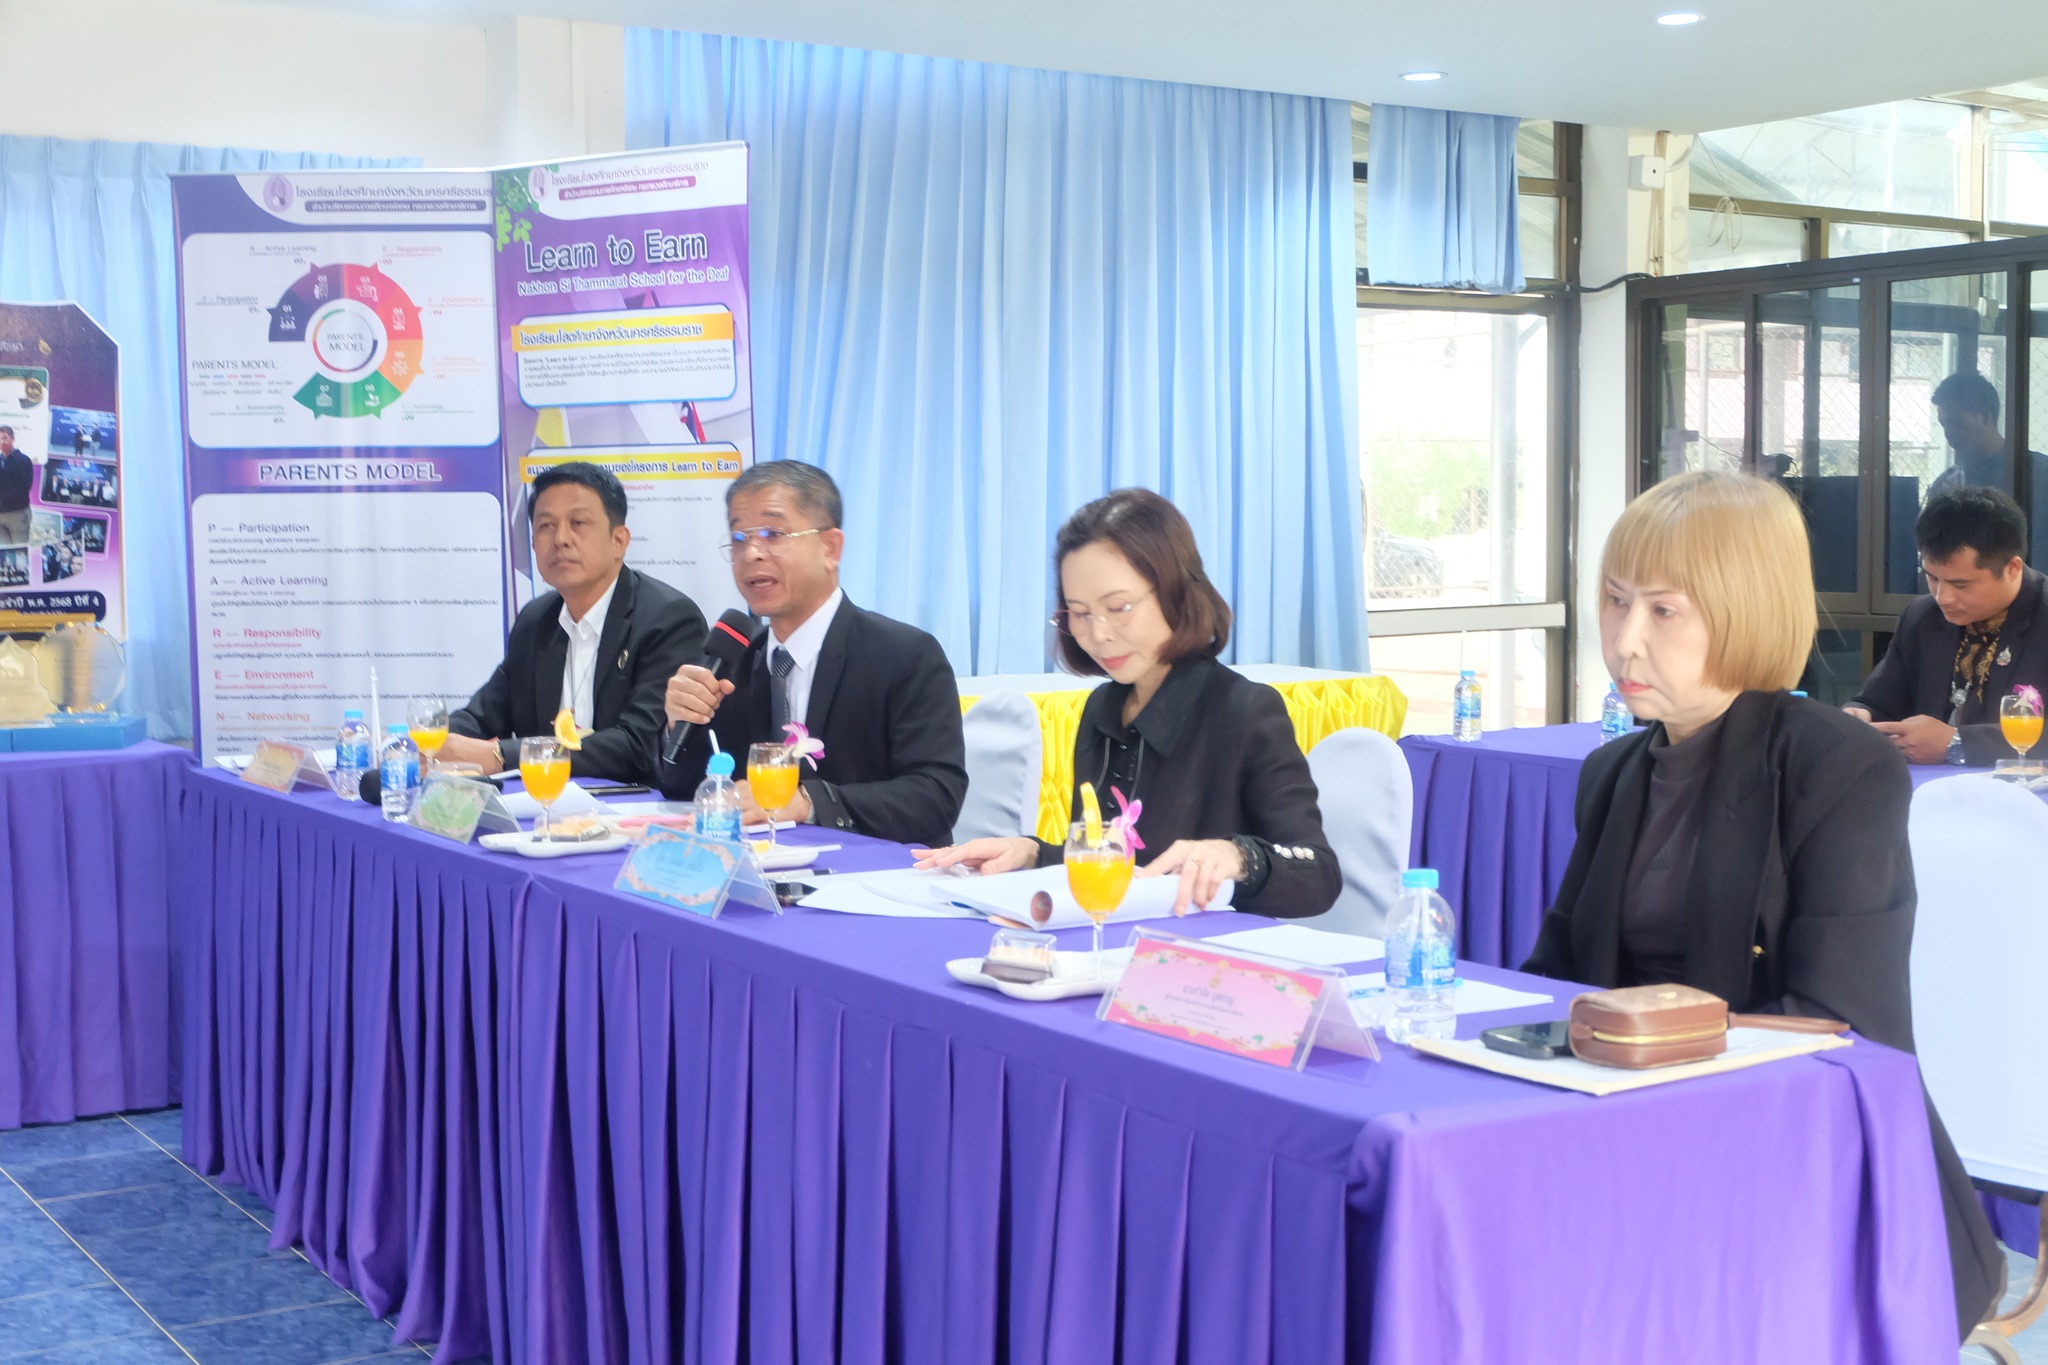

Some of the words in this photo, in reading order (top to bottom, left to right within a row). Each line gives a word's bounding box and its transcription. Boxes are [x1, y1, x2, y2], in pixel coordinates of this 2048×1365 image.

[526, 240, 597, 272] Learn
[606, 235, 634, 264] to
[645, 230, 708, 263] Earn
[518, 281, 557, 296] Nakhon
[560, 278, 571, 292] Si
[572, 275, 627, 291] Thammarat
[630, 272, 665, 287] School
[668, 270, 685, 285] for
[687, 268, 704, 283] the
[707, 266, 729, 281] Deaf
[192, 360, 238, 370] PARENTS
[241, 359, 278, 369] MODEL
[258, 463, 358, 482] PARENTS
[366, 461, 442, 482] MODEL
[671, 460, 698, 473] Learn
[701, 460, 714, 473] to
[717, 459, 739, 471] Earn
[208, 523, 216, 533] P
[239, 523, 310, 534] Participation
[210, 576, 219, 586] A
[240, 576, 276, 586] Active
[280, 575, 328, 587] Learning
[213, 628, 221, 638] R
[244, 628, 321, 640] Responsibility
[214, 669, 222, 680] E
[216, 712, 224, 721] N
[247, 712, 310, 723] Networking
